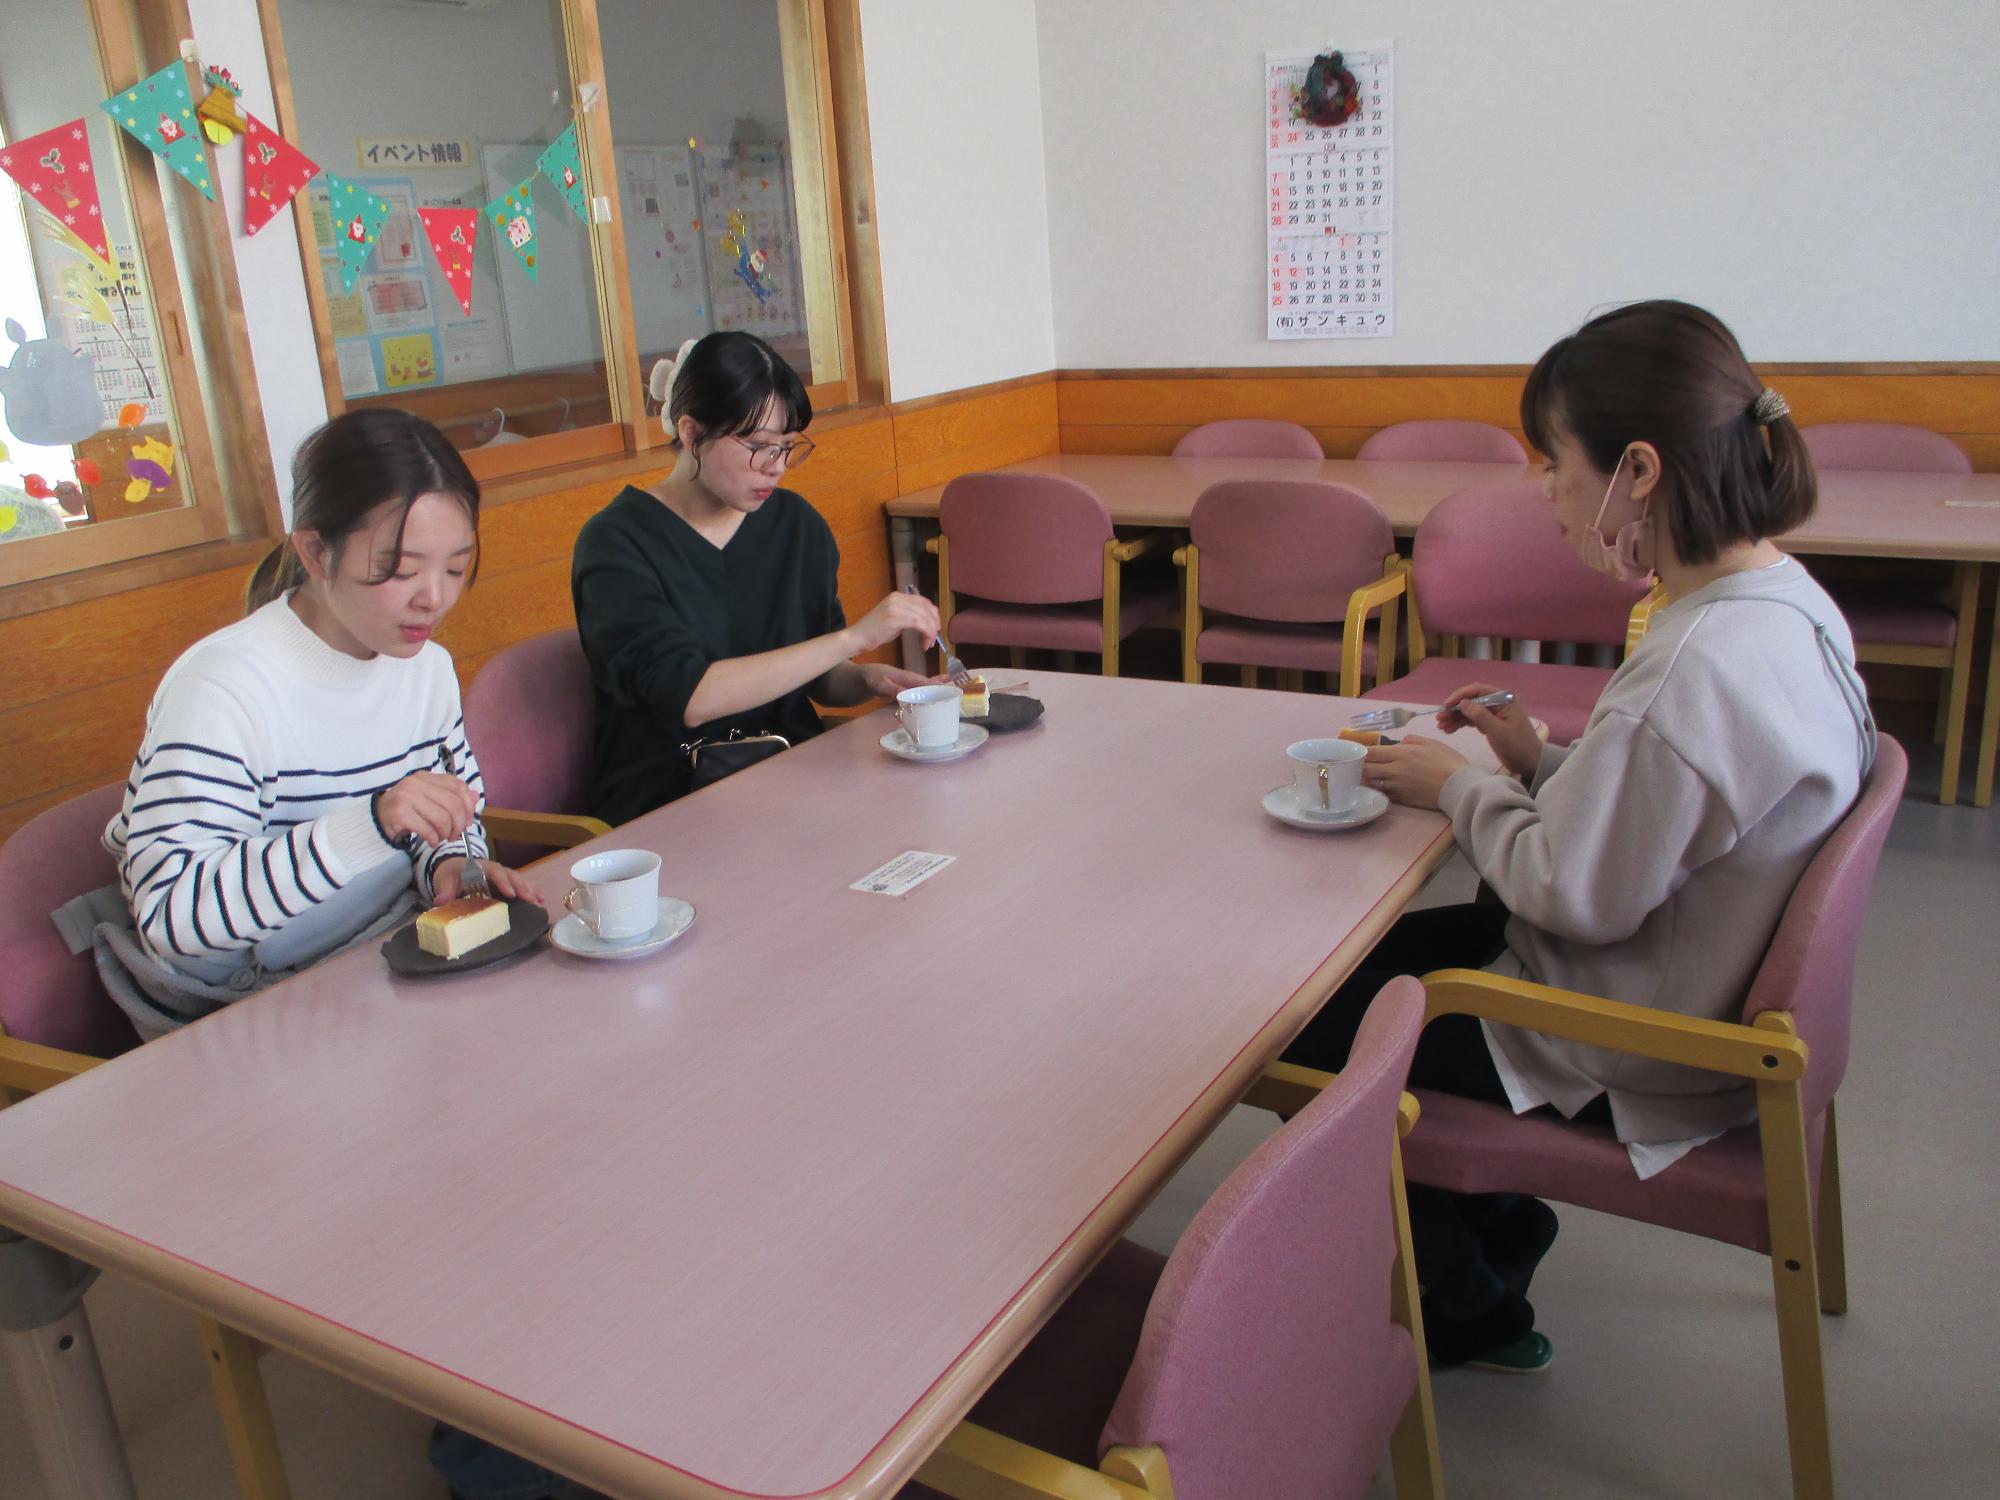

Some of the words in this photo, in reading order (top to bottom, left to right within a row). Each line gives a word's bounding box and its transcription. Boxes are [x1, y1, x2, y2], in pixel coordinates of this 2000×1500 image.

[1305, 131, 1315, 140] 25
[1322, 130, 1332, 139] 26
[1338, 129, 1348, 138] 27
[1356, 128, 1365, 137] 28
[367, 142, 462, 163] イベント情報
[1322, 170, 1330, 179] 10
[1339, 169, 1346, 178] 11
[1356, 168, 1364, 177] 12
[1372, 166, 1381, 176] 13
[1272, 188, 1280, 197] 14
[1289, 187, 1297, 196] 15
[1306, 185, 1314, 195] 16
[1323, 184, 1330, 194] 17
[1339, 183, 1347, 193] 18
[1356, 182, 1364, 192] 19
[1372, 181, 1382, 191] 20
[1272, 203, 1280, 212] 21
[1289, 201, 1298, 210] 22
[1306, 200, 1315, 209] 23
[1323, 199, 1332, 208] 24
[1339, 198, 1348, 208] 25
[1355, 197, 1365, 207] 26
[1372, 196, 1381, 206] 27
[1272, 217, 1281, 226] 28
[1289, 215, 1299, 225] 29
[1306, 214, 1316, 224] 30
[1322, 214, 1331, 223] 31
[1372, 250, 1381, 259] 10
[1273, 268, 1280, 278] 11
[1290, 268, 1298, 277] 12
[1306, 267, 1314, 276] 13
[1323, 266, 1331, 275] 14
[1340, 266, 1348, 275] 15
[1356, 265, 1364, 274] 16
[1373, 264, 1380, 274] 17
[1273, 283, 1281, 291] 18
[1290, 282, 1298, 291] 19
[1306, 281, 1316, 290] 20
[1323, 280, 1331, 290] 21
[1340, 280, 1349, 289] 22
[1356, 280, 1365, 289] 23
[1372, 279, 1381, 288] 24
[1272, 297, 1282, 305] 25
[1289, 295, 1299, 305] 26
[1306, 295, 1316, 304] 27
[1322, 294, 1333, 304] 28
[1339, 294, 1349, 303] 29
[1356, 294, 1365, 303] 30
[1372, 293, 1380, 303] 31
[1276, 314, 1385, 328] (有)サンキュウ
